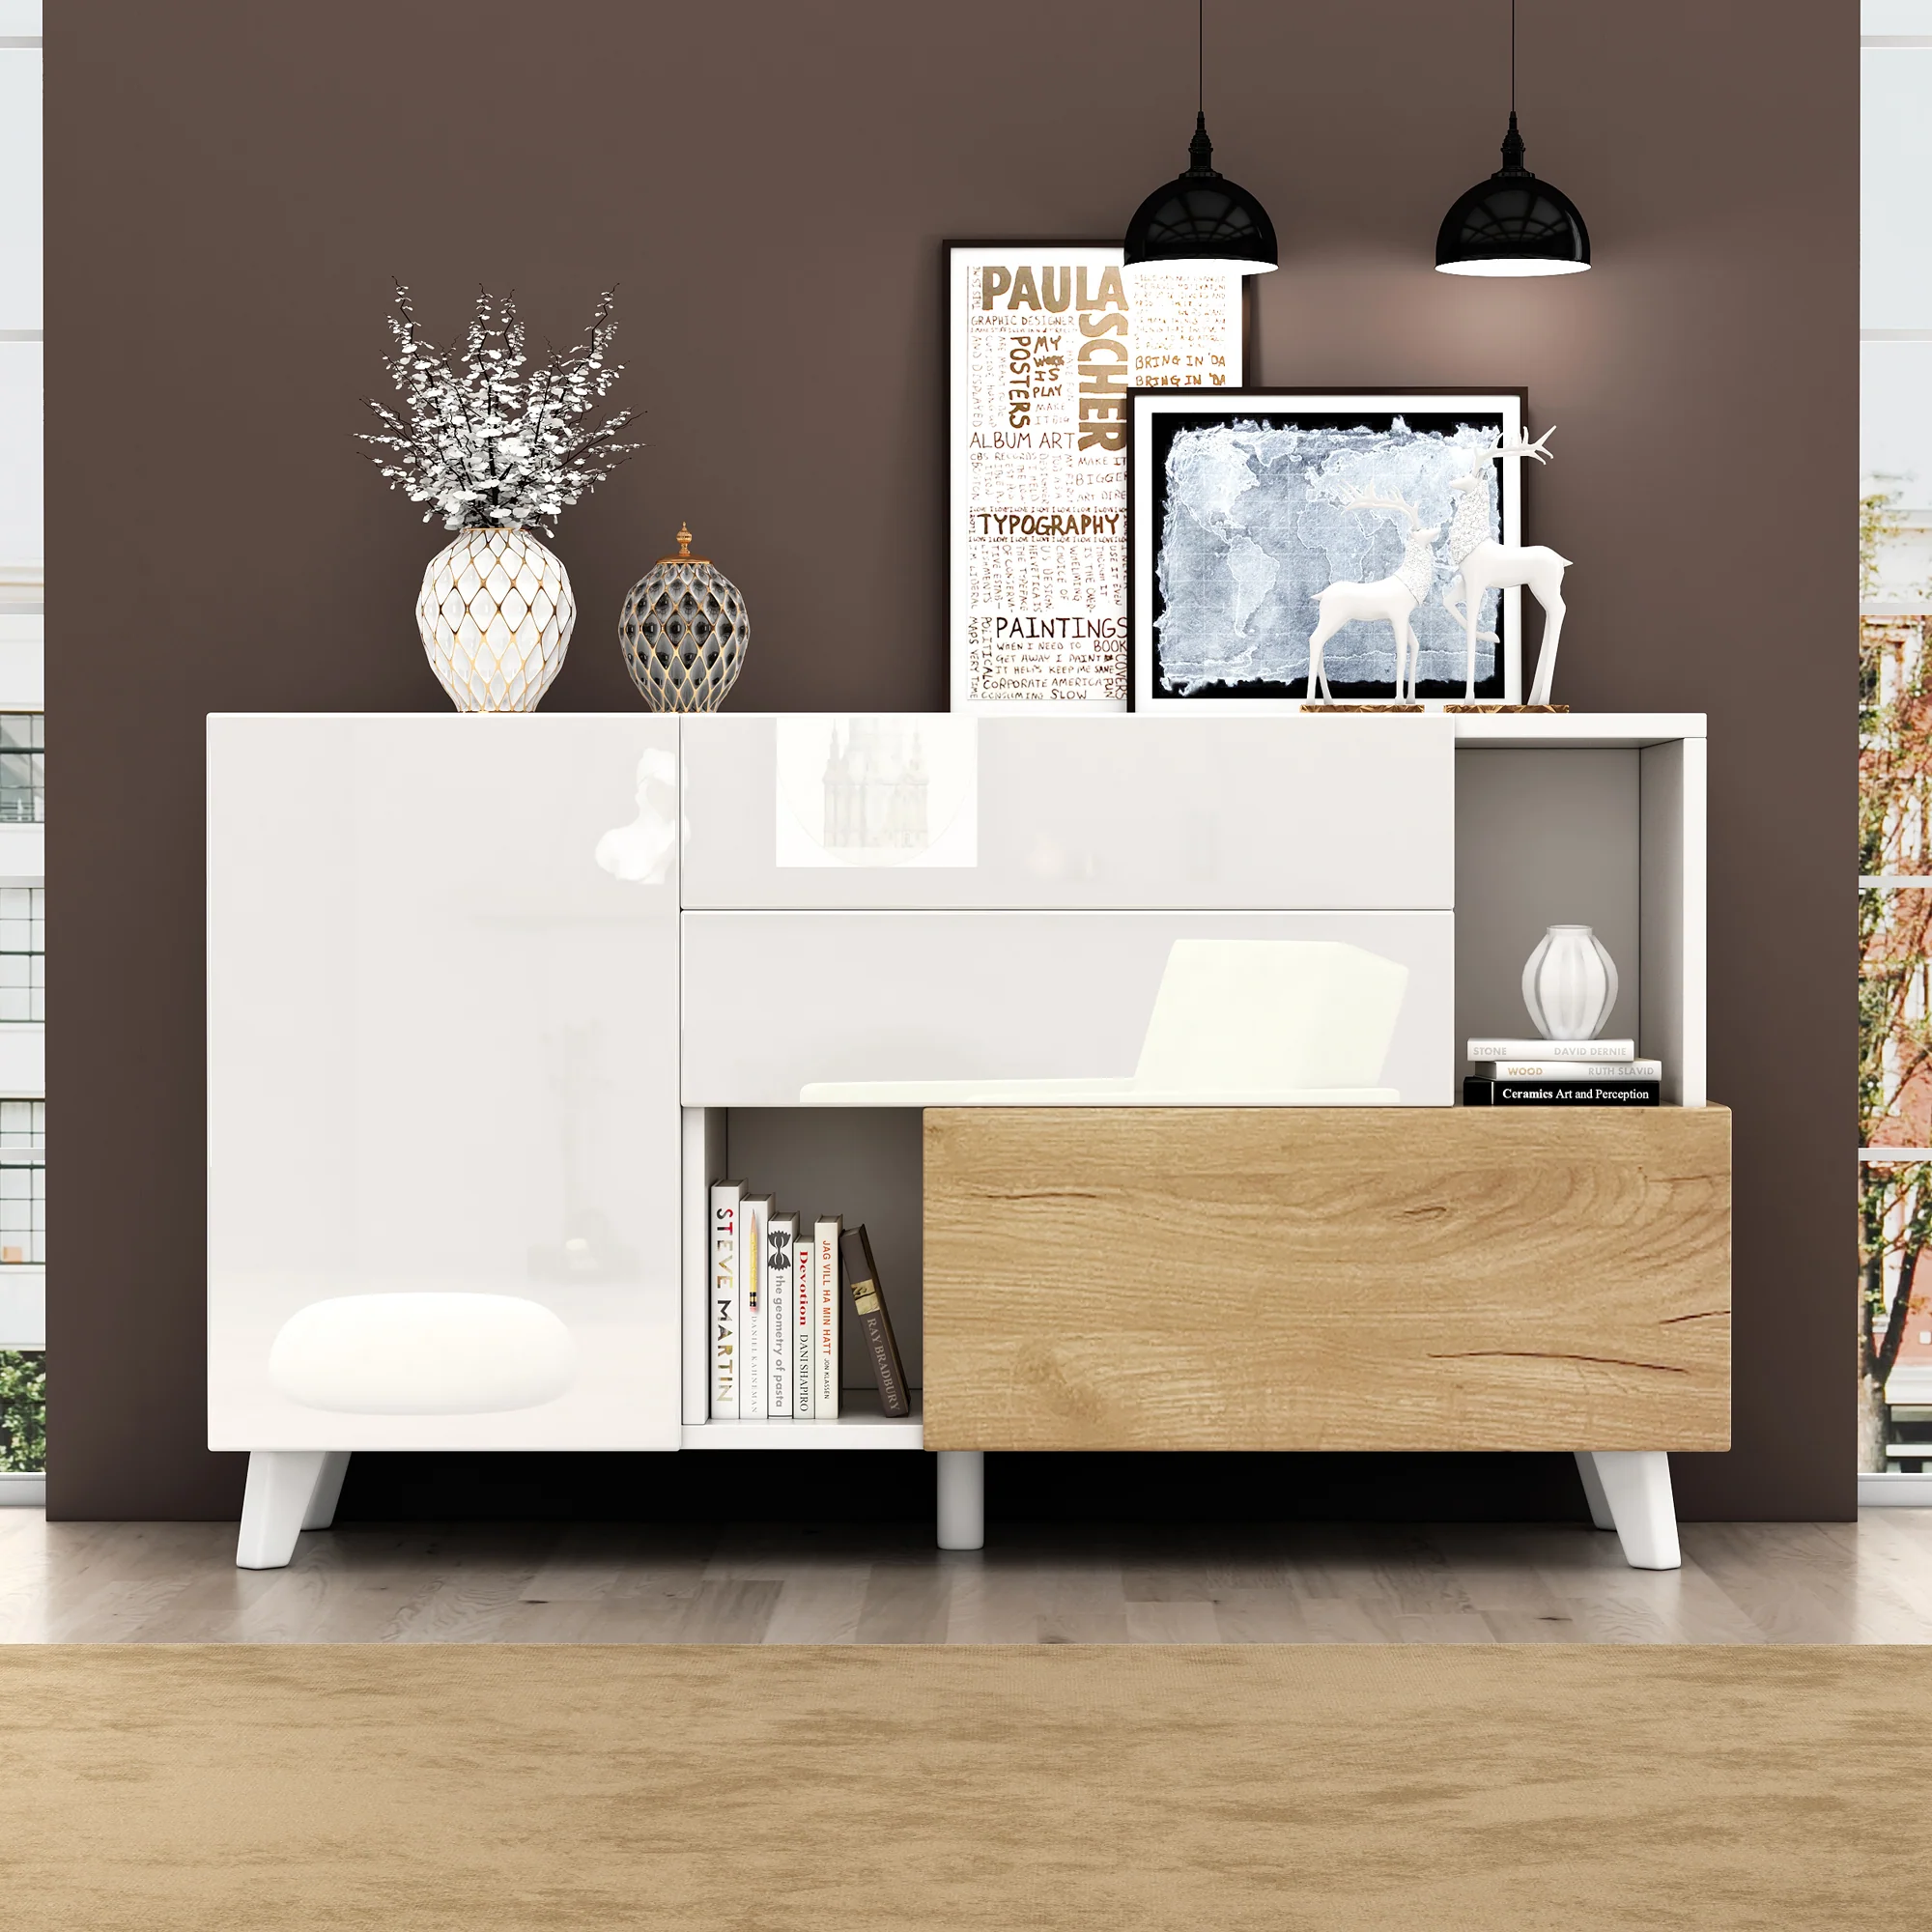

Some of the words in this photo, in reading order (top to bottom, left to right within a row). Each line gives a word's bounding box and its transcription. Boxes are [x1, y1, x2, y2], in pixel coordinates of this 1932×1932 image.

[972, 277, 981, 288] IS
[981, 266, 1129, 313] PAULA
[972, 291, 981, 310] THIS
[971, 315, 1017, 326] GRAPHIC
[1021, 315, 1075, 326] DESIGNER
[1034, 335, 1062, 354] MY
[1135, 355, 1180, 370] BRING
[1186, 355, 1204, 367] IN
[1009, 335, 1031, 429] POSTERS
[1035, 368, 1060, 382] IS
[1077, 313, 1129, 452] SCHER
[1135, 375, 1180, 387] BRING
[1184, 374, 1202, 386] IN
[972, 364, 983, 427] DISPLAYED
[1033, 384, 1063, 398] PLAY
[1036, 403, 1065, 412] MAKE
[970, 431, 1032, 449] ALBUM
[1039, 431, 1076, 449] ART
[970, 452, 989, 461] CBS
[994, 452, 1037, 461] RECORDS
[1078, 457, 1108, 467] MAKE
[1113, 457, 1127, 466] IT
[977, 513, 1121, 536] TYPOGRAPHY
[991, 545, 1002, 569] TIVE
[1016, 546, 1027, 562] THE
[1084, 547, 1094, 559] IS
[1108, 545, 1118, 562] USE
[1029, 545, 1041, 599] HELVETICA
[1056, 546, 1066, 583] CHOICE
[1085, 565, 1095, 583] THE
[1111, 566, 1120, 580] IT
[1060, 588, 1069, 601] OF
[1099, 584, 1108, 597] IT
[1112, 583, 1122, 606] EVEN
[968, 616, 980, 644] MAPS
[996, 616, 1127, 639] PAINTINGS
[981, 616, 993, 680] POLITICAL
[1037, 641, 1064, 650] NEED
[1070, 641, 1082, 650] TO
[1094, 639, 1127, 653] BOOK
[969, 650, 980, 672] VERY
[996, 654, 1016, 664] GET
[1021, 654, 1051, 663] AWAY
[1056, 654, 1063, 663] I
[1068, 654, 1102, 663] PAINT
[995, 666, 1008, 674] IT
[1049, 665, 1074, 674] KEEP
[1077, 665, 1091, 674] ME
[1094, 666, 1115, 674] SANE
[1115, 654, 1127, 699] COVERS
[969, 676, 980, 698] TIME
[982, 677, 1048, 690] CORPORATE
[1052, 677, 1102, 688] AMERICA
[1050, 689, 1087, 700] SLOW
[1473, 1047, 1507, 1056] STONE
[1554, 1047, 1587, 1056] DAVID
[1590, 1047, 1627, 1056] DERNIE
[1588, 1066, 1615, 1075] RUTH
[1618, 1066, 1655, 1075] SLAVID
[1502, 1089, 1553, 1099] Ceramics
[1555, 1089, 1574, 1099] Art
[1575, 1089, 1593, 1099] and
[1596, 1089, 1649, 1101] Perception
[717, 1208, 733, 1290] STEVE
[822, 1240, 831, 1261] JAG
[822, 1263, 831, 1286] VILL
[776, 1275, 785, 1294] the
[799, 1251, 809, 1326] Devotion
[822, 1290, 831, 1304] HA
[822, 1307, 831, 1325] MIN
[773, 1297, 783, 1356] geometry
[867, 1318, 882, 1343] RAY
[717, 1299, 733, 1402] MARTIN
[800, 1334, 809, 1362] DANI
[822, 1329, 831, 1355] HATT
[776, 1359, 785, 1372] of
[874, 1346, 900, 1410] BRADBURY
[773, 1375, 783, 1407] pasta
[800, 1364, 809, 1412] SHAPIRO
